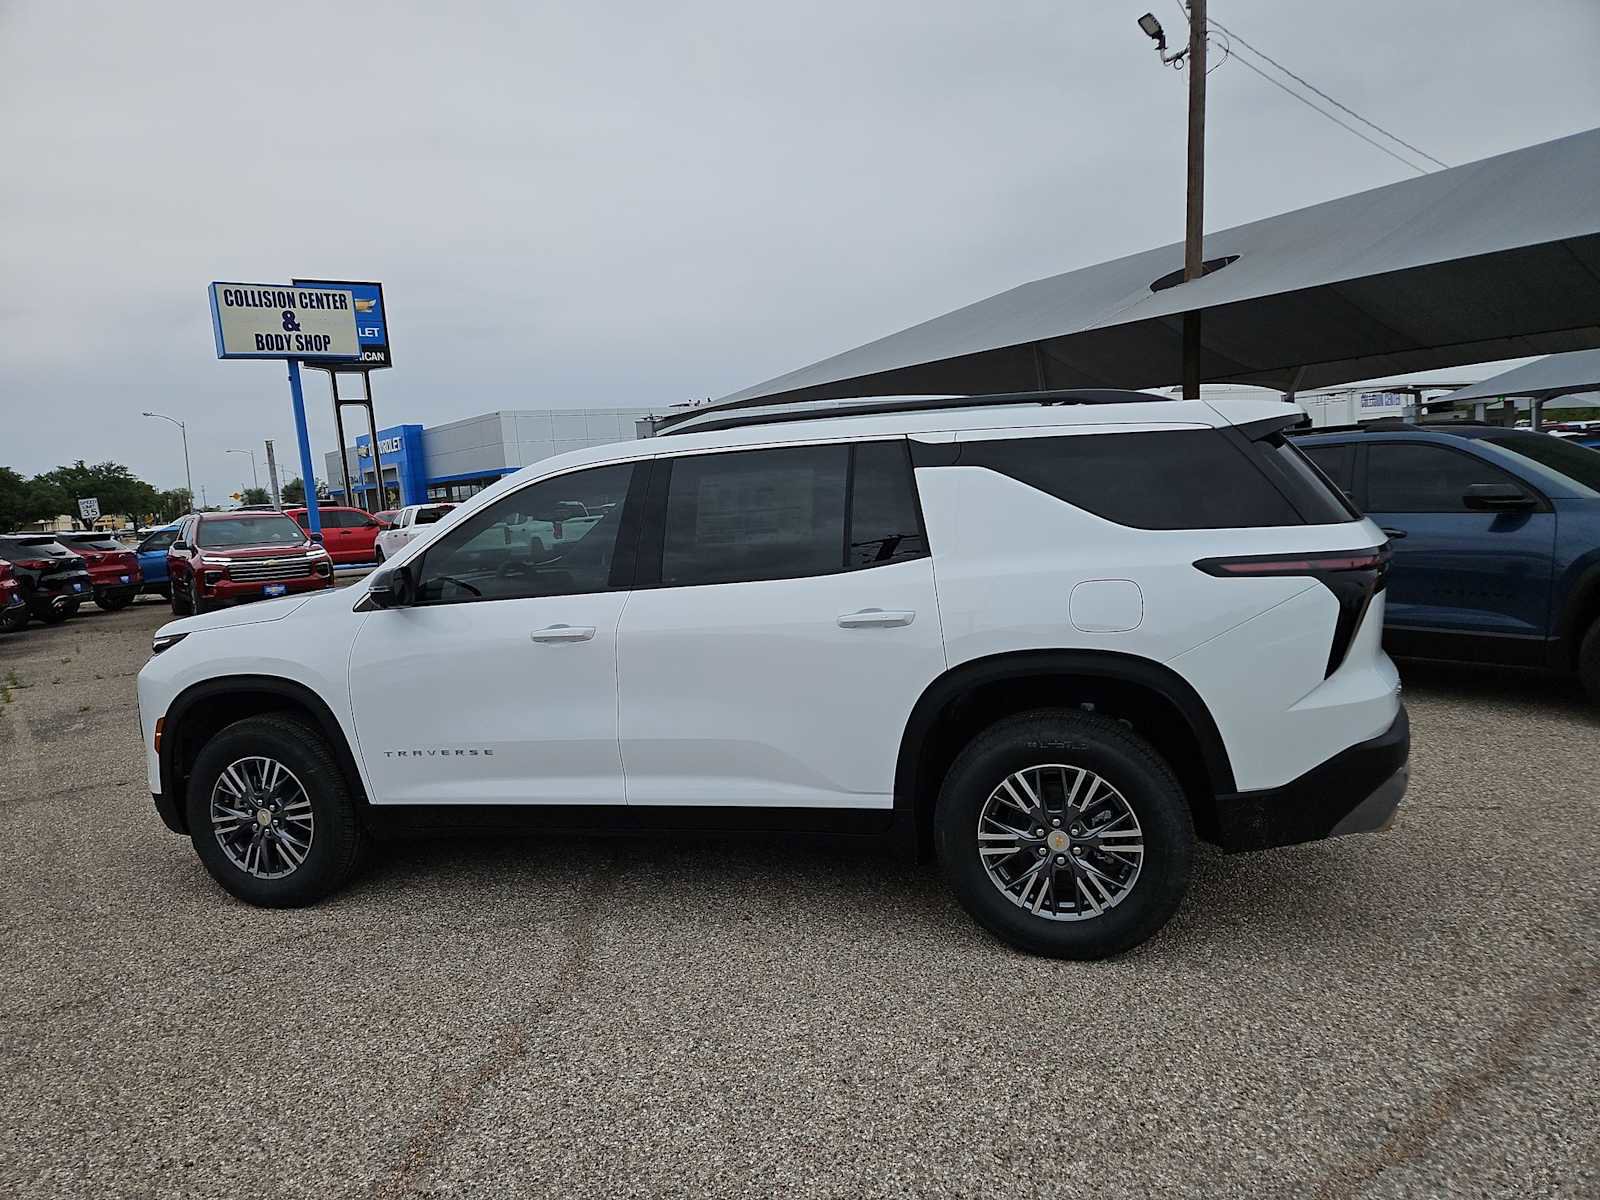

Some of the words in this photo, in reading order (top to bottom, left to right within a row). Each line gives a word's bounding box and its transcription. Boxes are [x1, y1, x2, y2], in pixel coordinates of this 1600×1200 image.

[223, 288, 297, 309] COLLISION
[300, 291, 348, 310] CENTER
[281, 310, 301, 332] &
[255, 333, 292, 351] BODY
[295, 334, 331, 352] SHOP
[83, 508, 98, 517] 35
[383, 749, 494, 758] TRAVERSE
